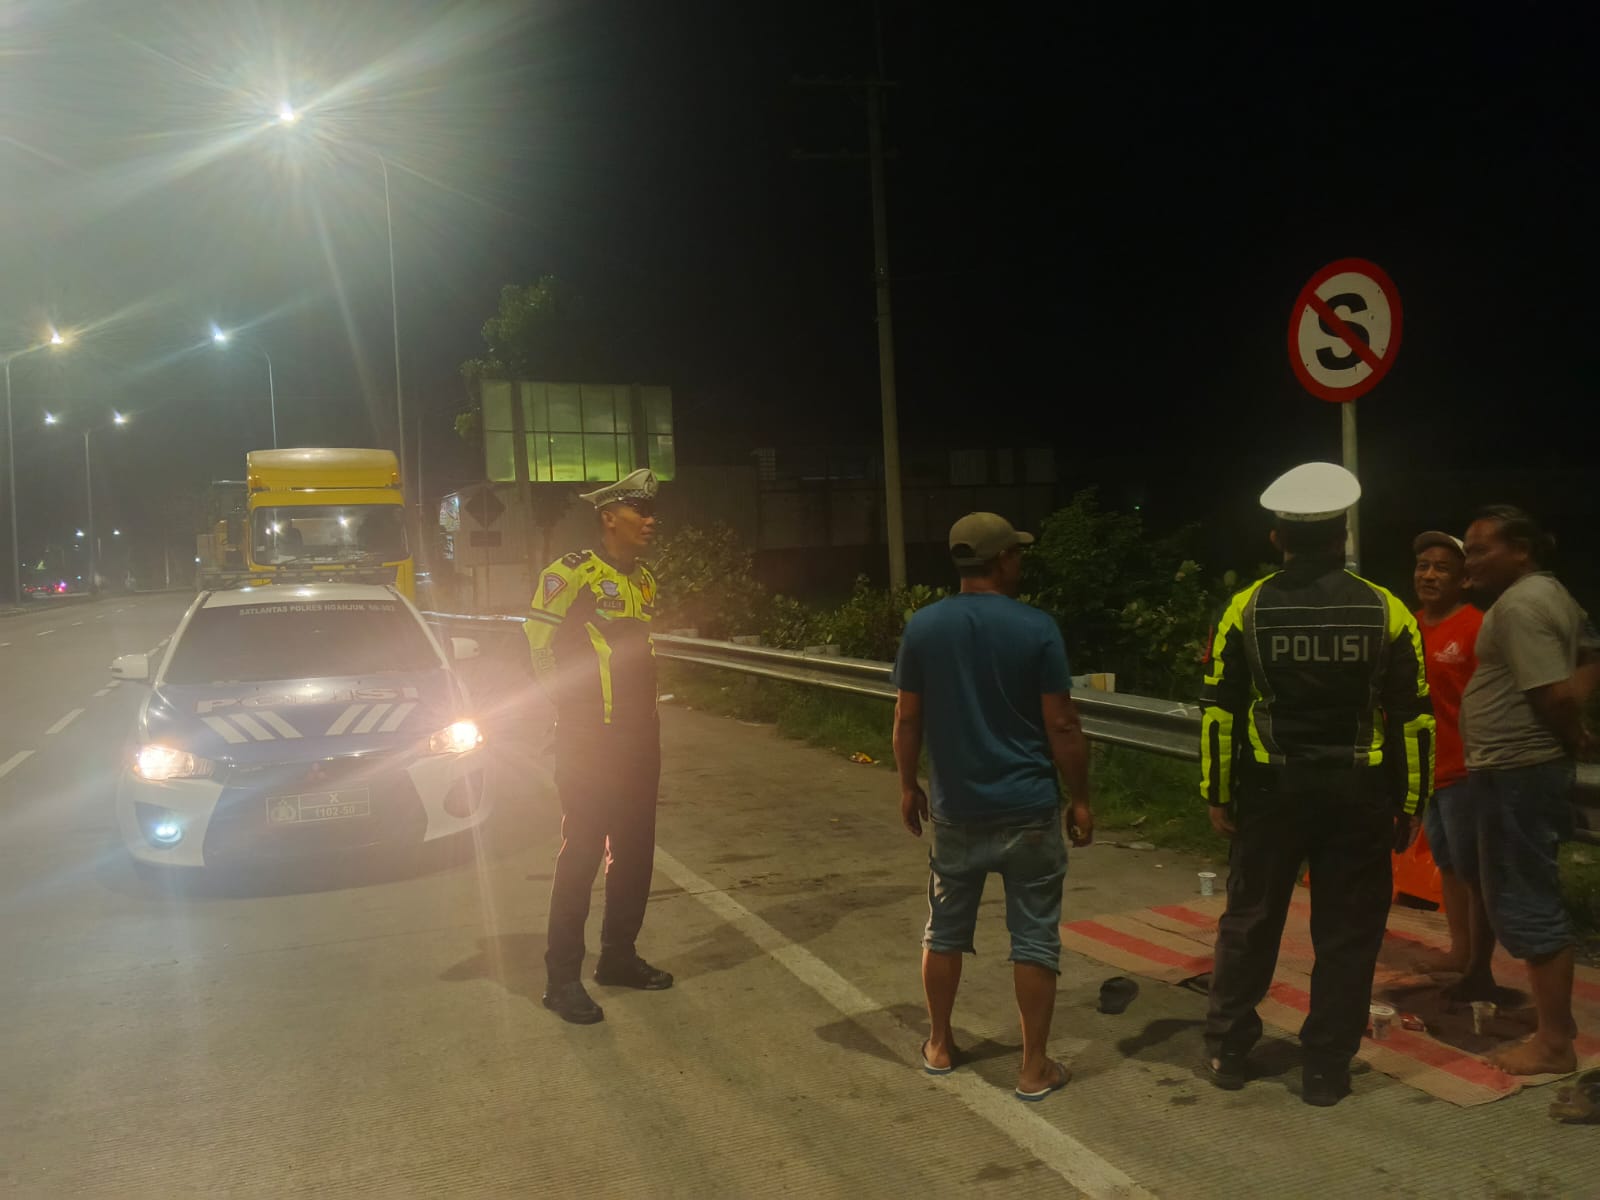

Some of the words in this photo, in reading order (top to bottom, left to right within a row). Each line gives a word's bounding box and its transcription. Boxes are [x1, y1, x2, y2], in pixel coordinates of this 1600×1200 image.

[1316, 293, 1370, 370] S
[239, 604, 288, 616] SATLANTAS
[290, 603, 323, 613] POLRES
[1271, 634, 1369, 662] POLISI
